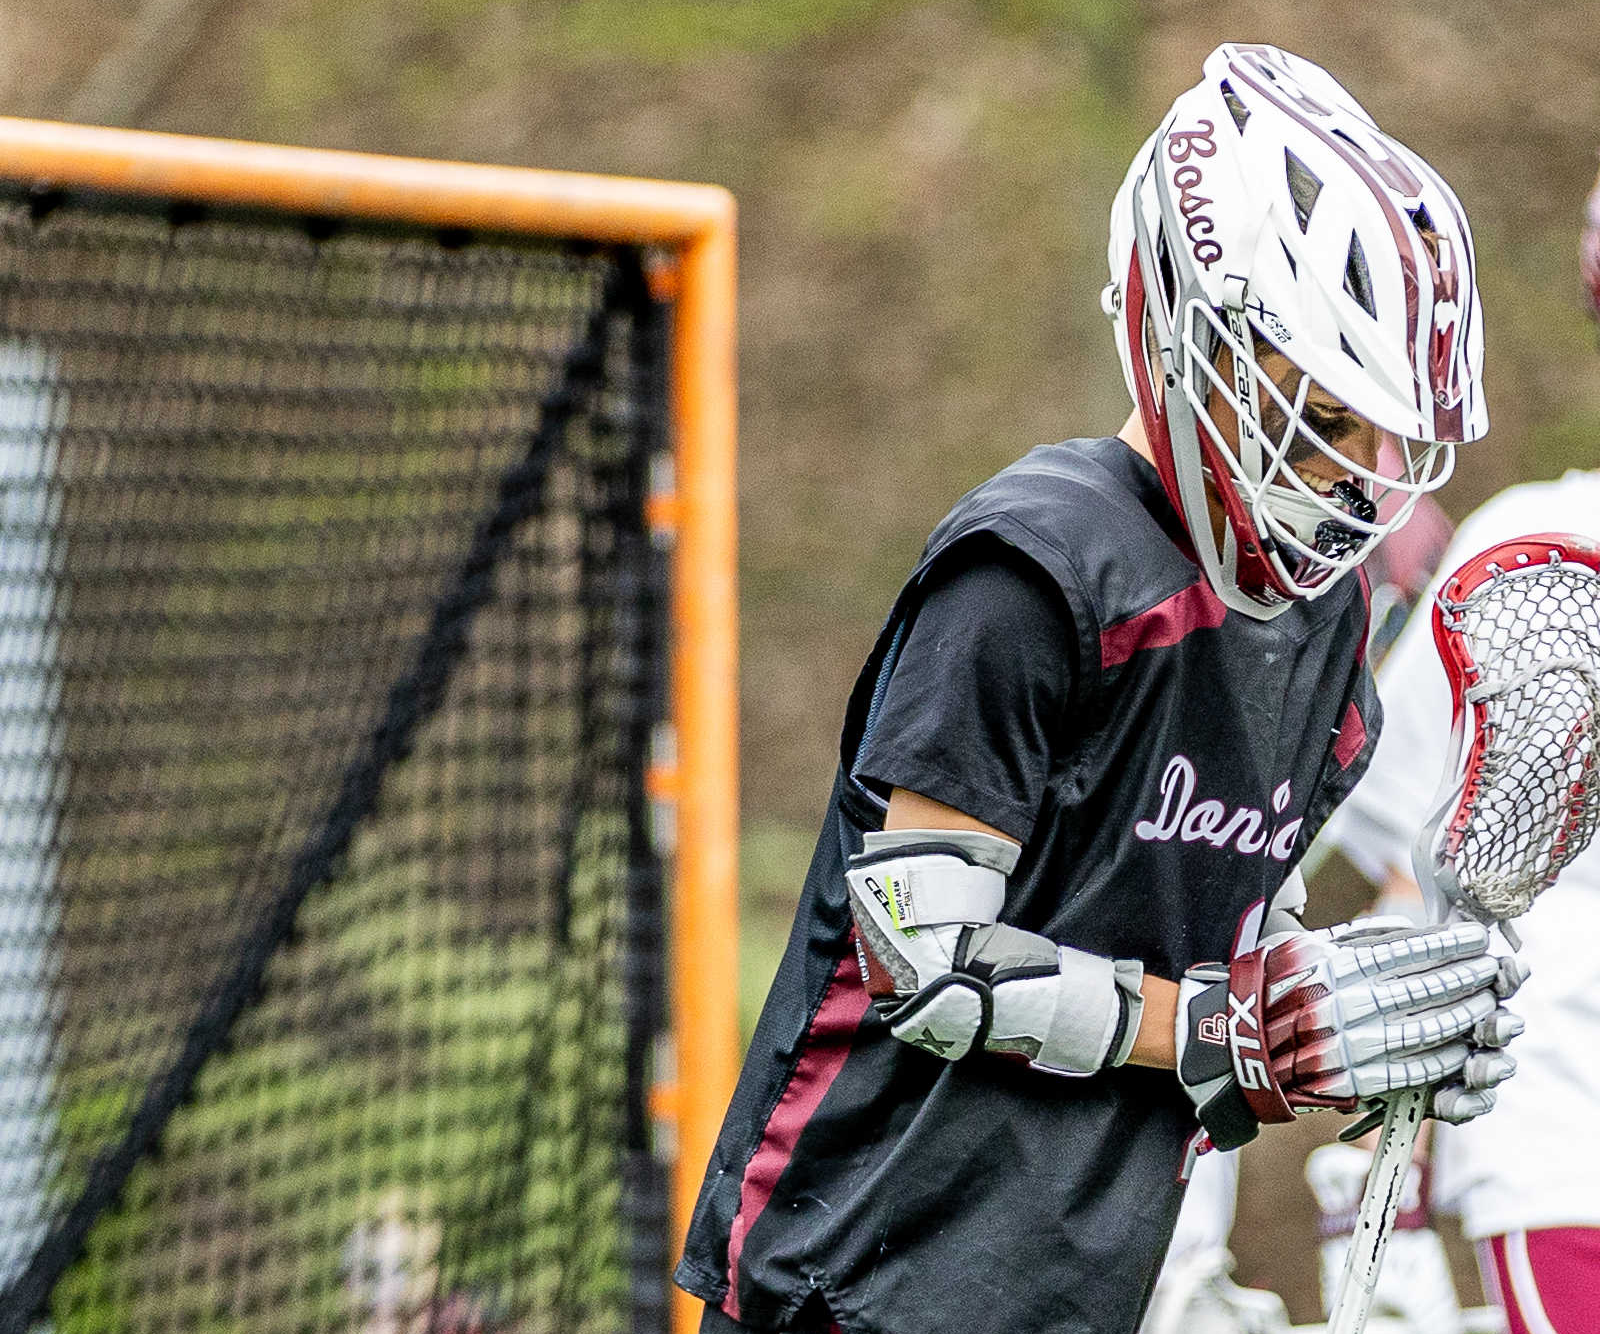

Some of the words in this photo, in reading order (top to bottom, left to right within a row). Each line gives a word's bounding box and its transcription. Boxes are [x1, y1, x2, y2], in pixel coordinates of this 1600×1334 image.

[1168, 119, 1223, 271] Bosco
[864, 876, 893, 919] CEL
[1229, 991, 1273, 1091] STX
